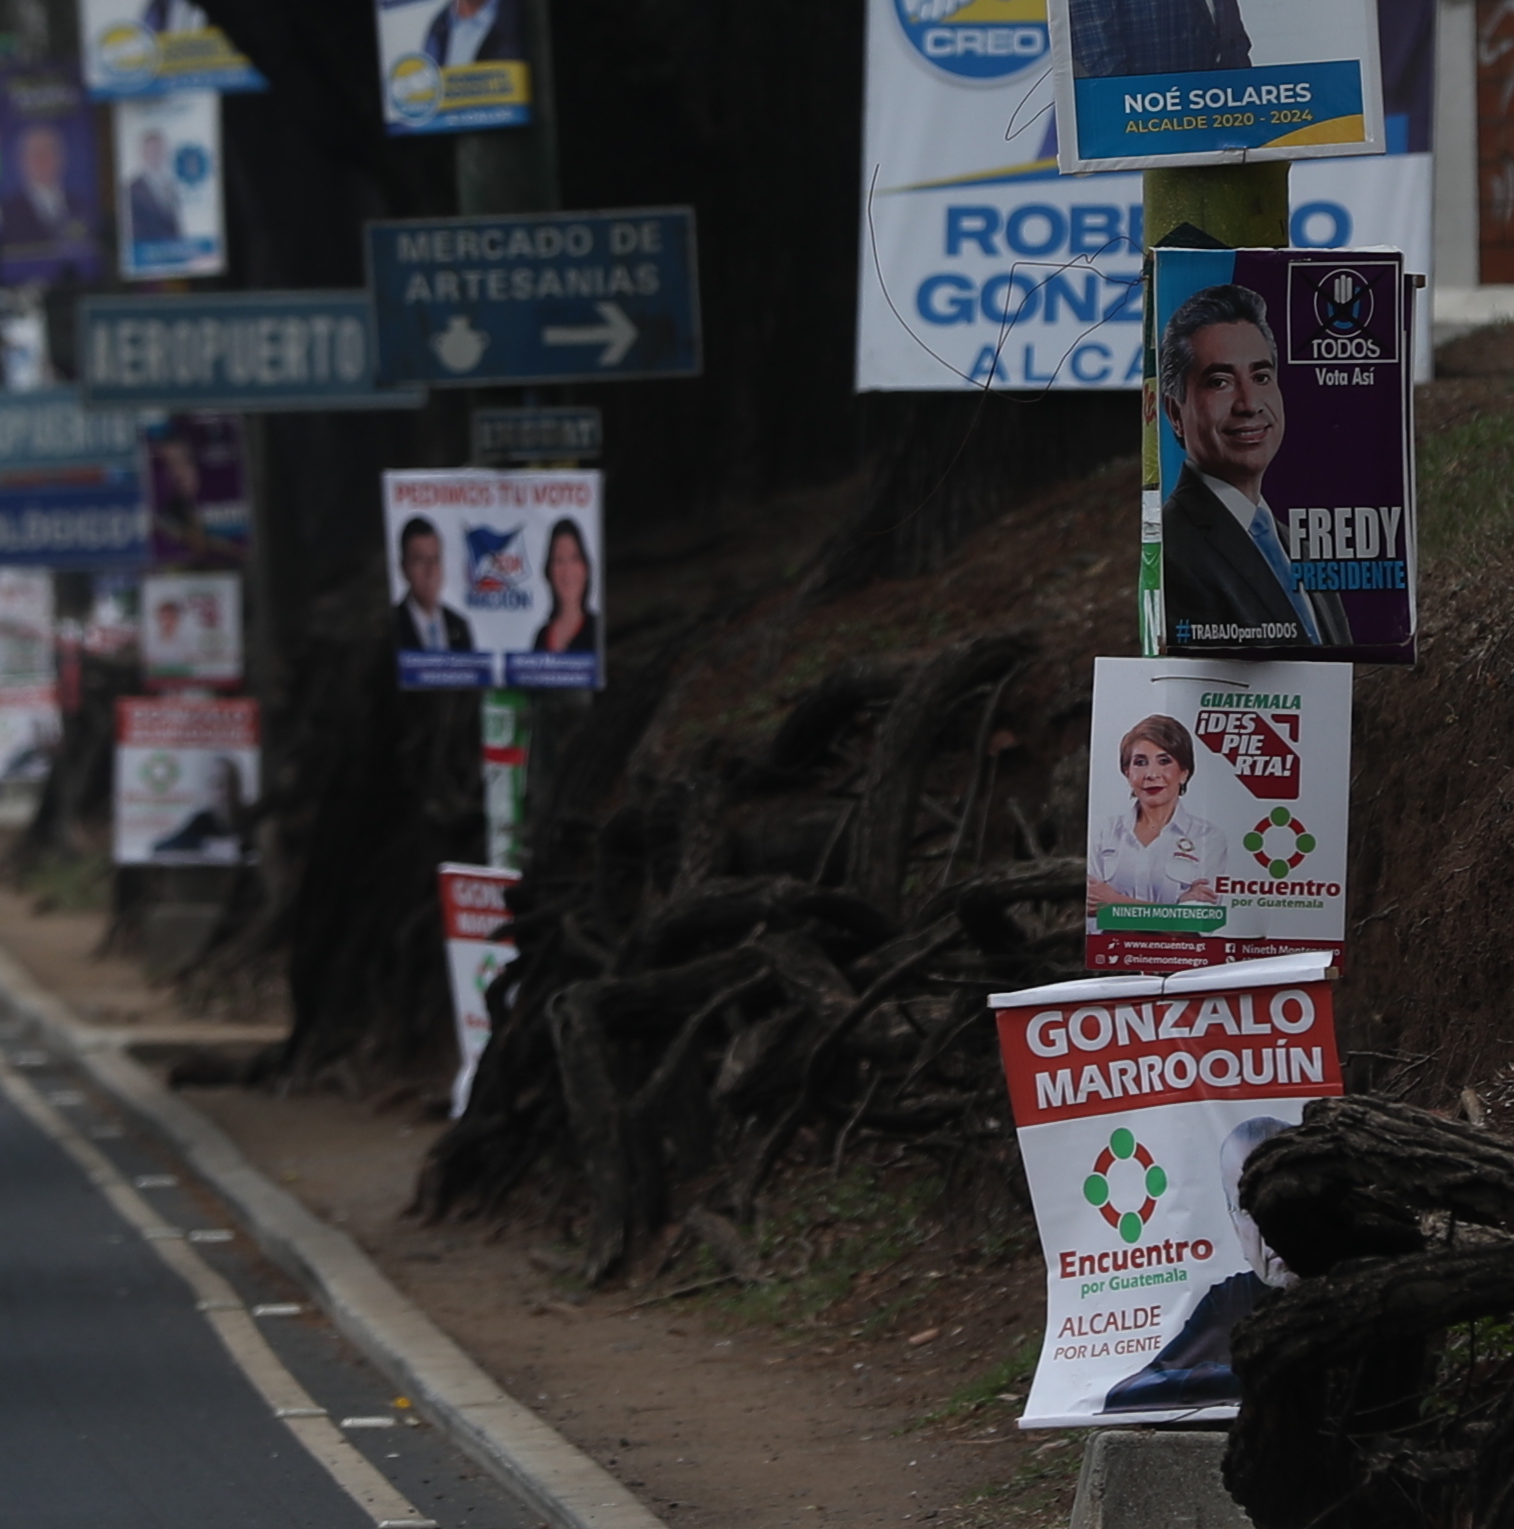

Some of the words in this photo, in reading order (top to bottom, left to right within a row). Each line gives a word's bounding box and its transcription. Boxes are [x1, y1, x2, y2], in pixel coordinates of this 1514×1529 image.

[923, 27, 1044, 57] CREO
[1124, 86, 1182, 114] NOÉ
[1189, 82, 1312, 110] SOLARES
[1125, 115, 1208, 134] ALCALDE
[1212, 112, 1254, 128] 2020
[1270, 108, 1314, 124] 2024
[395, 225, 594, 264] MERCADO
[610, 222, 664, 256] DE
[404, 263, 661, 304] ARTESANIAS
[914, 272, 1143, 327] GONZ
[92, 314, 368, 387] AEROPUERTO
[1311, 338, 1381, 359] TODOS
[1315, 367, 1348, 386] Vota
[1352, 366, 1375, 386] Así
[394, 482, 495, 507] PEDIMOS
[534, 481, 592, 507] VOTO
[1288, 506, 1402, 560] FREDY
[1290, 560, 1406, 591] PRESIDENTE
[1175, 618, 1298, 644] #TRABAJOparaTODOS
[1199, 692, 1302, 710] GUATEMALA
[1197, 712, 1257, 735] ¡DES
[1221, 734, 1265, 755] PIE
[1235, 754, 1295, 777] RTA!
[1214, 876, 1342, 897] Encuentro
[1111, 906, 1151, 918] NINETH
[1152, 907, 1224, 920] MONTENEGRO
[1231, 899, 1253, 909] por
[1256, 897, 1325, 909] Guatemala
[1123, 955, 1209, 967] @ninemontenegro
[1241, 944, 1277, 955] Nineth
[1025, 989, 1316, 1058] GONZALO
[1035, 1038, 1324, 1110] MARROQUÍN
[1058, 1237, 1214, 1279] Encuentro
[1080, 1280, 1106, 1299] por
[1108, 1268, 1188, 1292] Guatemala
[1057, 1304, 1162, 1339] ALCALDE
[1053, 1344, 1089, 1360] POR
[1090, 1342, 1110, 1358] LA
[1114, 1334, 1162, 1355] GENTE
